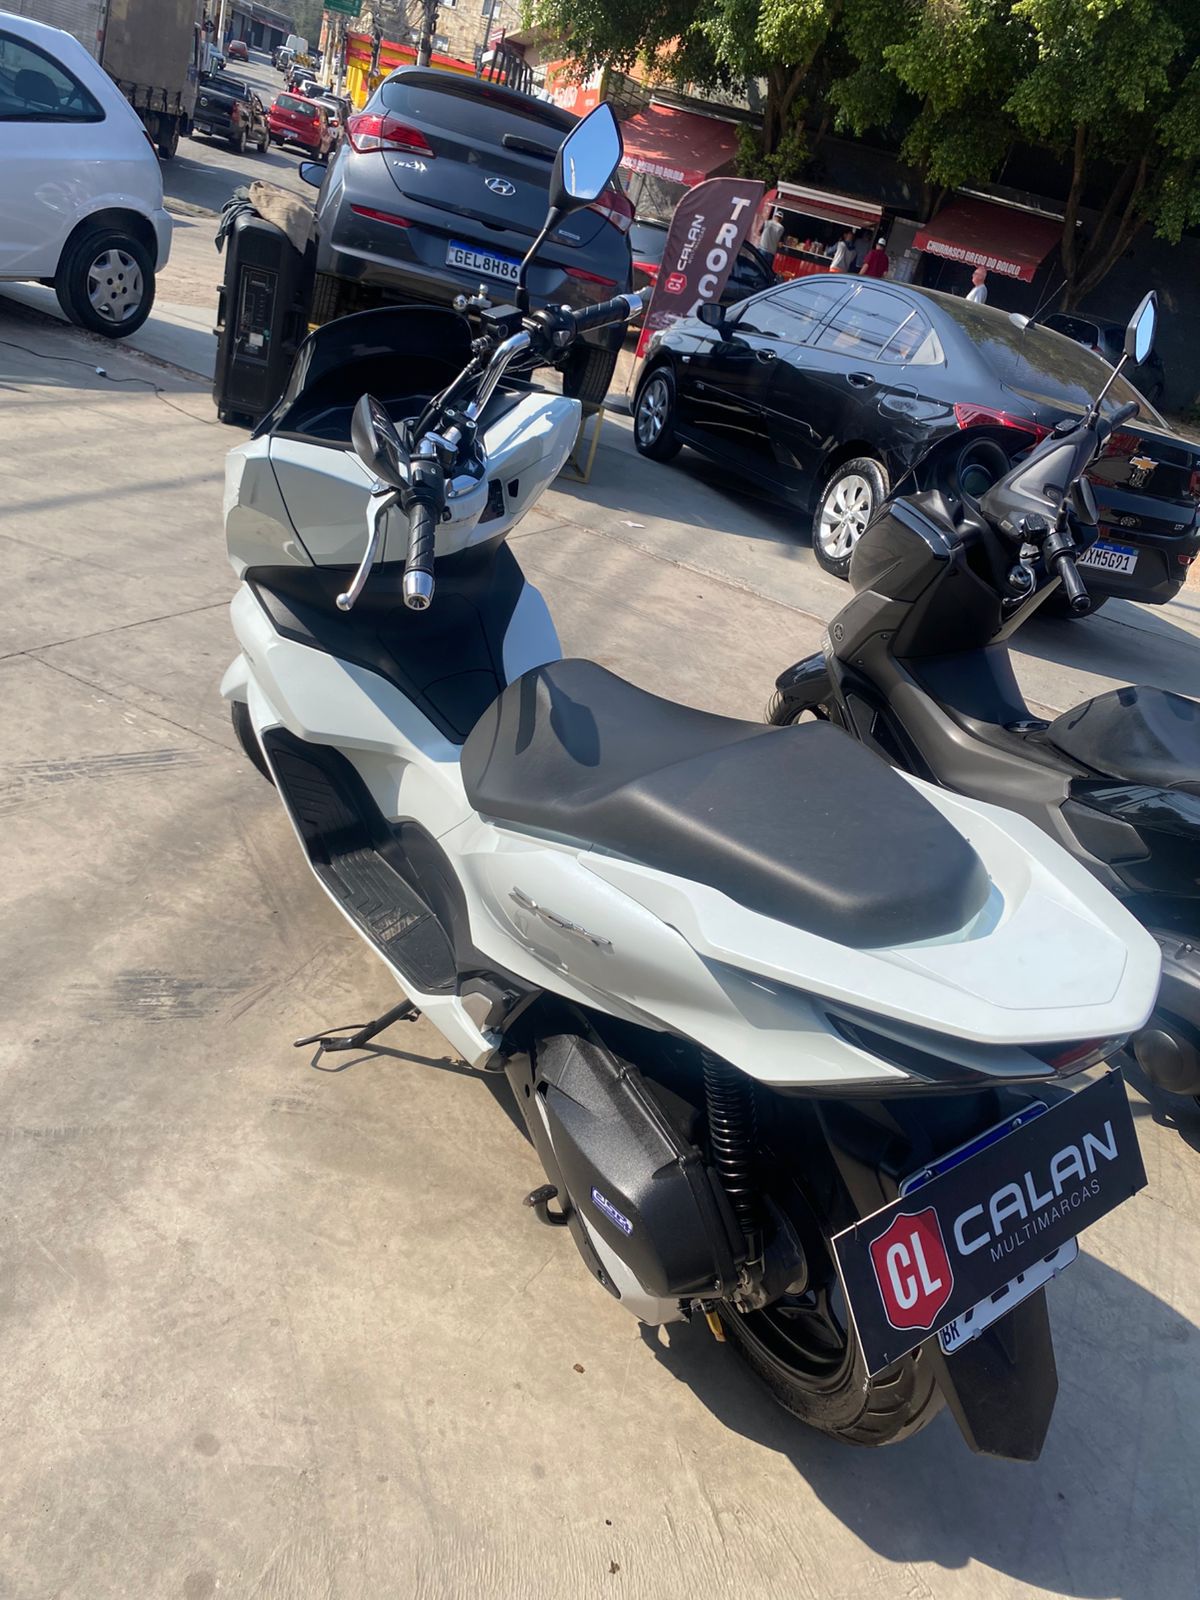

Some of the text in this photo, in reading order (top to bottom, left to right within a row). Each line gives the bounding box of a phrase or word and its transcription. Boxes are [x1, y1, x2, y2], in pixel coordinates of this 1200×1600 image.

[454, 249, 518, 279] GEL8H86
[677, 214, 704, 271] CALAN
[667, 277, 684, 291] CL
[953, 1119, 1119, 1256] CALAN
[990, 1178, 1101, 1263] MULTIMARCAS
[886, 1231, 943, 1310] CL
